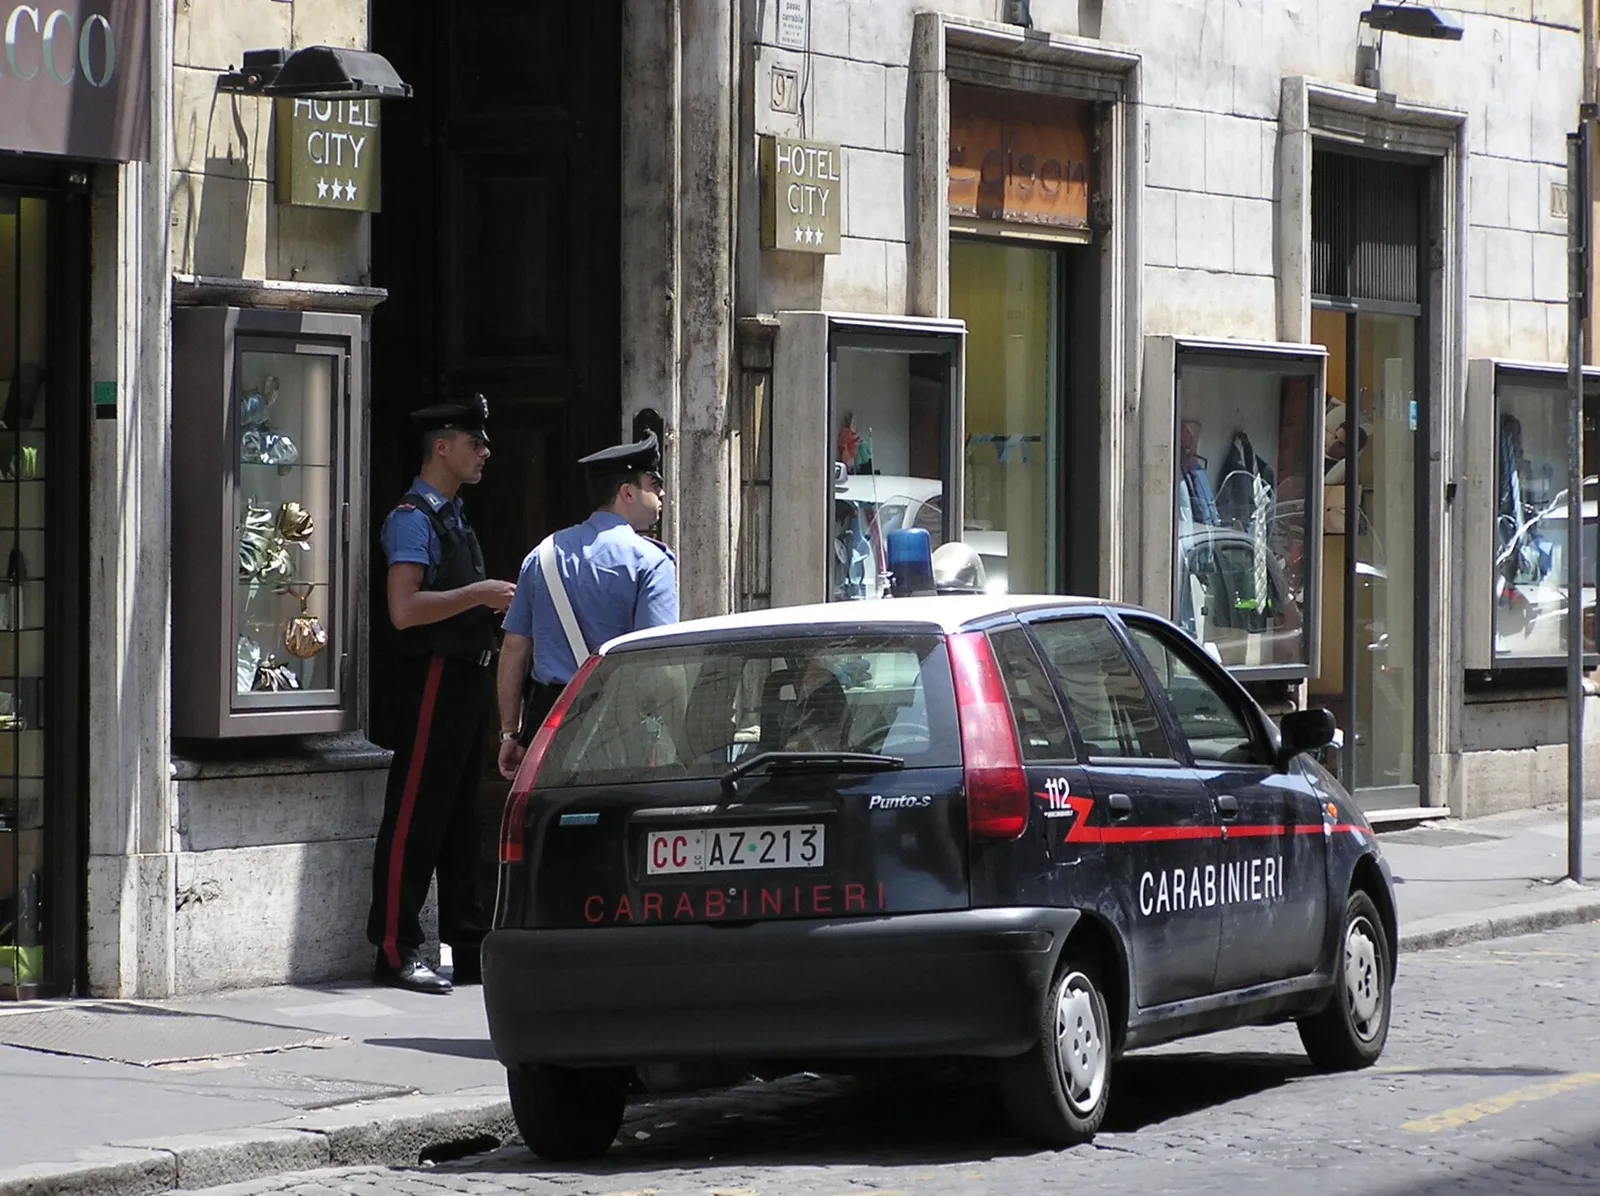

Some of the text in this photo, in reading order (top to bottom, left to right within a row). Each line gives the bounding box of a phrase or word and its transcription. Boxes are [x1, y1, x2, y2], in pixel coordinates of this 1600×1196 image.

[0, 4, 115, 88] CCO
[773, 73, 794, 111] 97
[293, 98, 378, 128] HOTEL
[307, 131, 366, 168] CITY
[776, 144, 840, 181] HOTEL
[787, 184, 830, 217] CITY
[1044, 777, 1072, 809] 112
[653, 829, 818, 868] CC AZ 213
[584, 882, 885, 923] CARABINIERI
[1139, 855, 1284, 916] CARABINIERI
